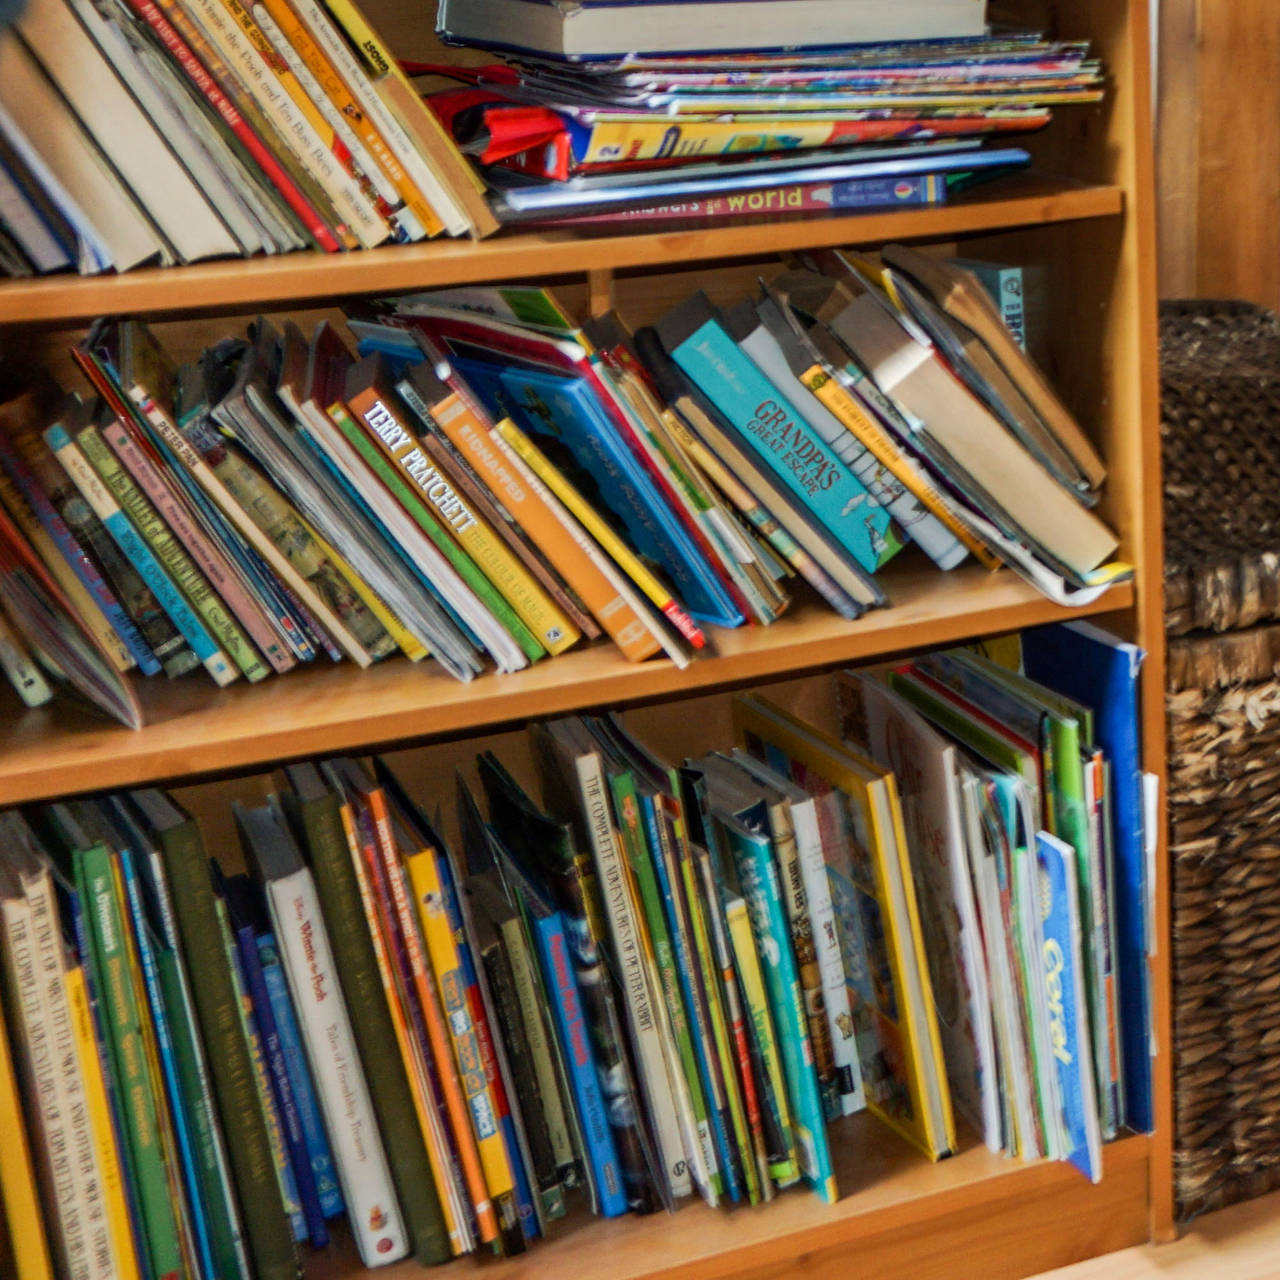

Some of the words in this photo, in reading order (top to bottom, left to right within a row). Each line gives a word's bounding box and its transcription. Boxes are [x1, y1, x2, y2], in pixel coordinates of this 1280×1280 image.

[360, 38, 391, 73] GHOST
[728, 188, 803, 211] world
[156, 420, 184, 450] PETER
[179, 448, 198, 468] PAN
[364, 400, 412, 453] TERRY
[401, 445, 480, 534] PRATCHETT
[457, 422, 526, 504] KIDNAPPED
[746, 418, 789, 465] GREAT
[784, 455, 818, 499] ESCAPE
[753, 399, 842, 492] GRANDPA'S
[119, 486, 157, 528] VALLEY
[157, 535, 211, 604] ADVENTURE
[583, 775, 601, 797] THE
[374, 819, 395, 864] HORTON
[386, 864, 405, 900] HEARS
[588, 800, 616, 862] COMPLETE
[7, 918, 28, 942] THE
[29, 894, 47, 917] THE
[94, 890, 118, 952] Dinosaurs
[604, 864, 634, 936] ADVENTURES
[34, 921, 54, 952] TALE
[296, 919, 319, 961] Winnie
[309, 972, 330, 1002] Pooh
[621, 938, 636, 954] OF
[11, 946, 43, 1015] COMPLETE
[625, 954, 644, 992] PETER
[266, 1033, 279, 1052] The
[632, 992, 654, 1034] RABBIT
[24, 1020, 61, 1103] ADVENTURES
[450, 1009, 468, 1034] BIG
[470, 1092, 494, 1136] SPACE
